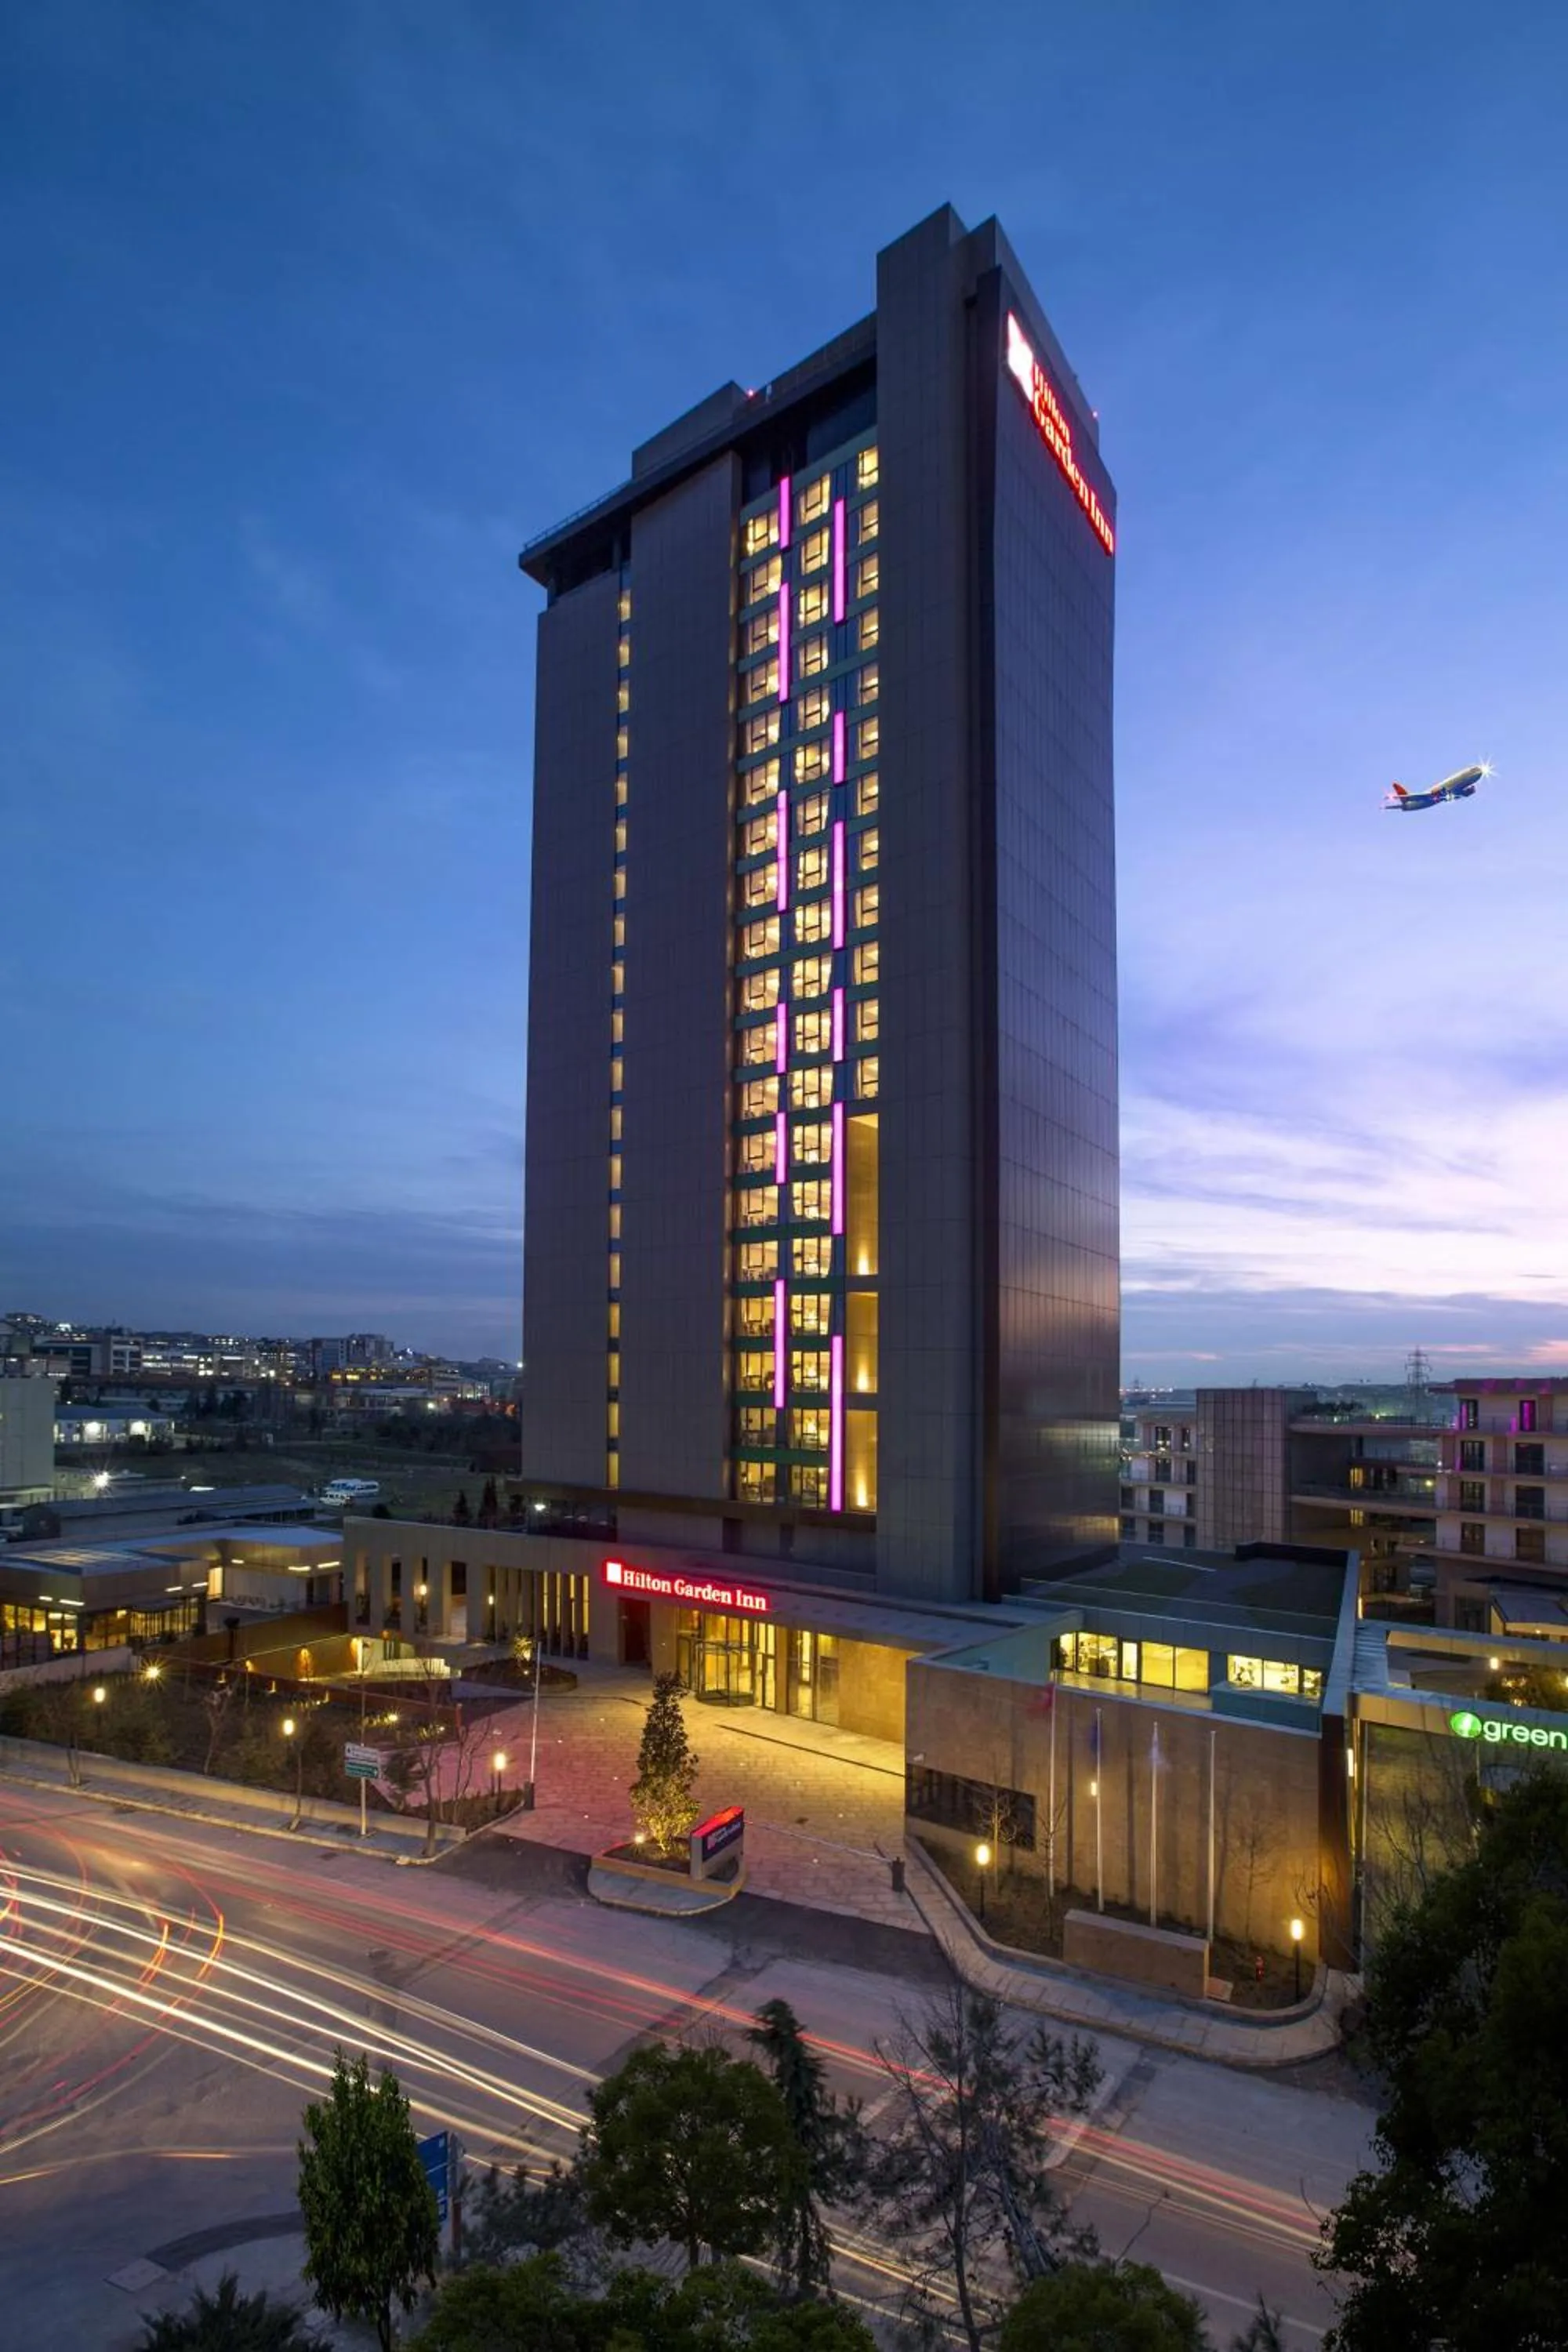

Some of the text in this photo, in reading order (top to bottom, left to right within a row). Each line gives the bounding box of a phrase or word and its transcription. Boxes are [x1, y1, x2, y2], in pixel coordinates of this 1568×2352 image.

[1034, 390, 1114, 554] Garden Inn
[623, 1570, 767, 1611] Hilton Garden Inn
[1483, 1720, 1567, 1750] green
